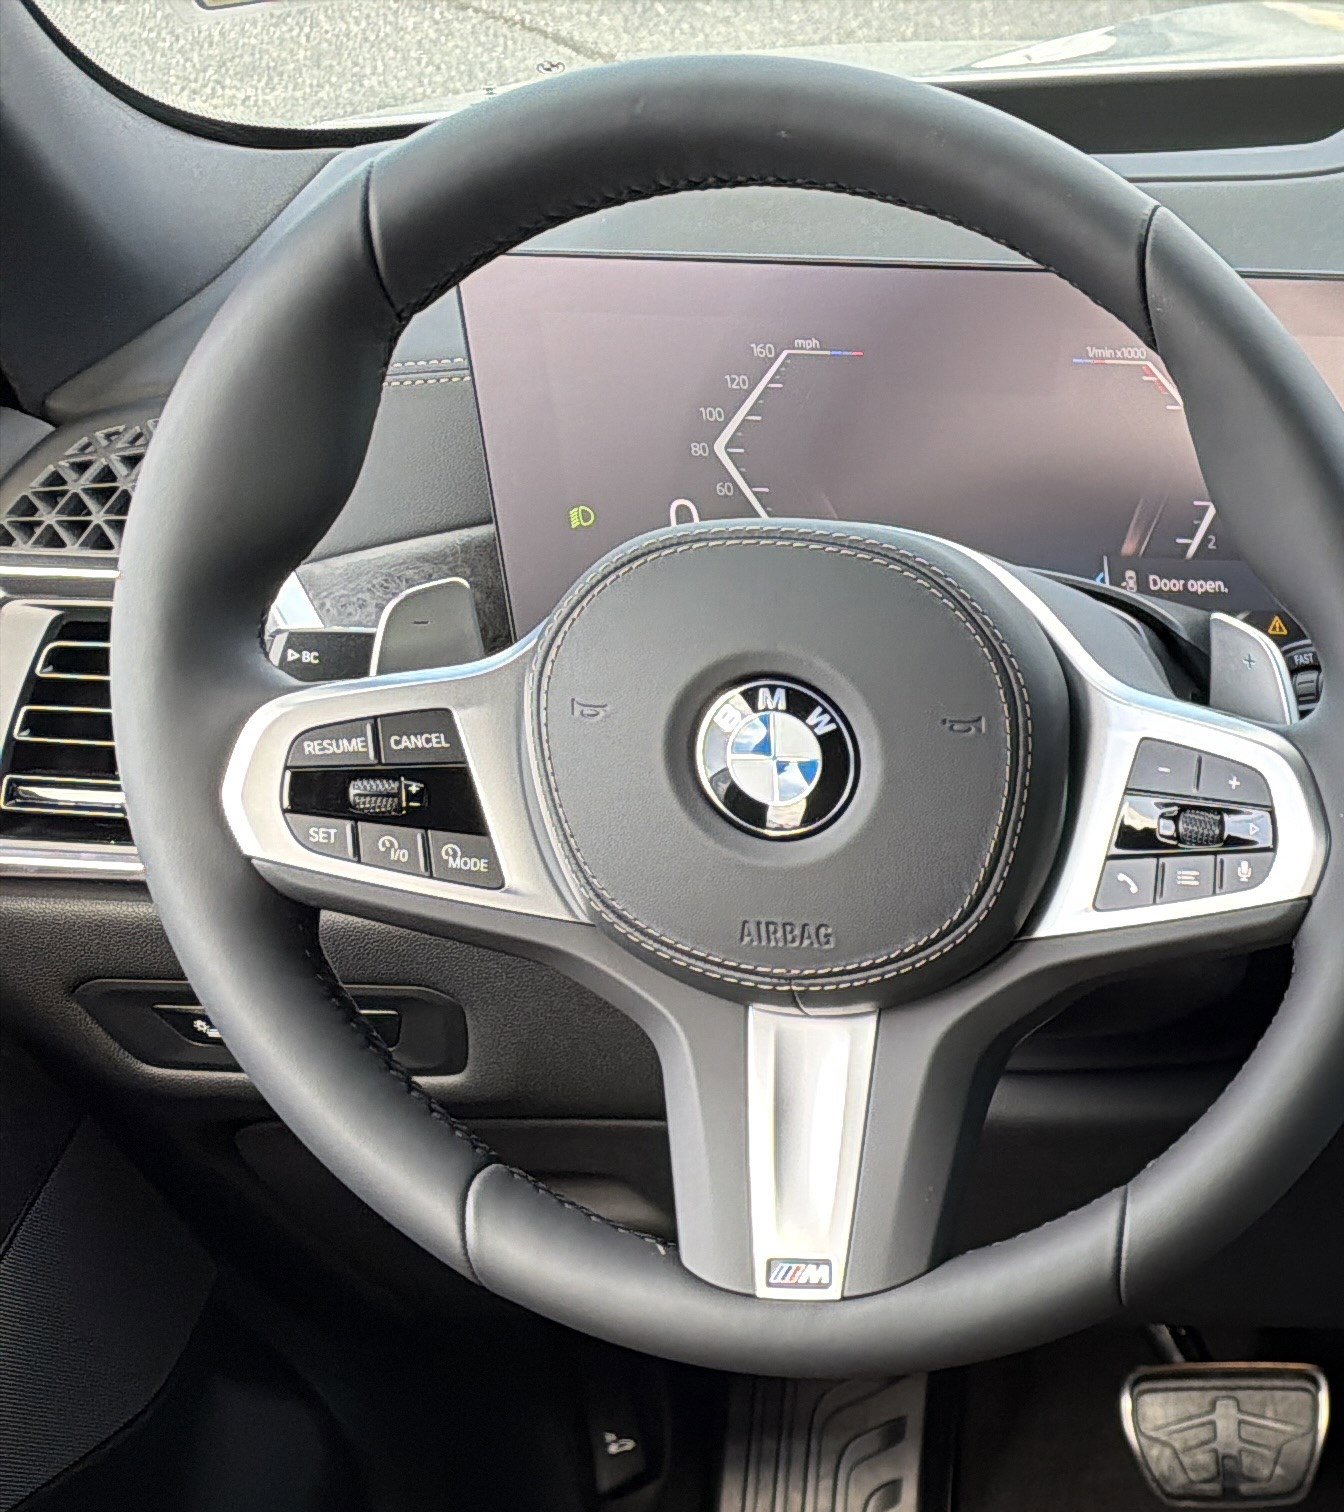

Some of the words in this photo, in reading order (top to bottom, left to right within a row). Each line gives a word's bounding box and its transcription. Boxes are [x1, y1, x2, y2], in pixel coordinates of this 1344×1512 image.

[751, 343, 775, 357] 160
[794, 338, 820, 349] mph
[1115, 347, 1147, 359] x1000
[725, 374, 749, 389] 120
[700, 407, 724, 421] 100
[690, 442, 709, 456] 80
[716, 482, 734, 496] 60
[1207, 535, 1217, 550] 2
[1148, 574, 1184, 592] Door
[1187, 579, 1229, 594] open.
[302, 650, 320, 664] BC
[1294, 653, 1314, 665] FAST
[713, 687, 837, 736] BMW
[303, 737, 367, 755] RESUME
[389, 732, 450, 750] CANCEL
[308, 827, 337, 844] SET
[448, 855, 489, 872] MODE
[740, 919, 836, 949] AIRBAG
